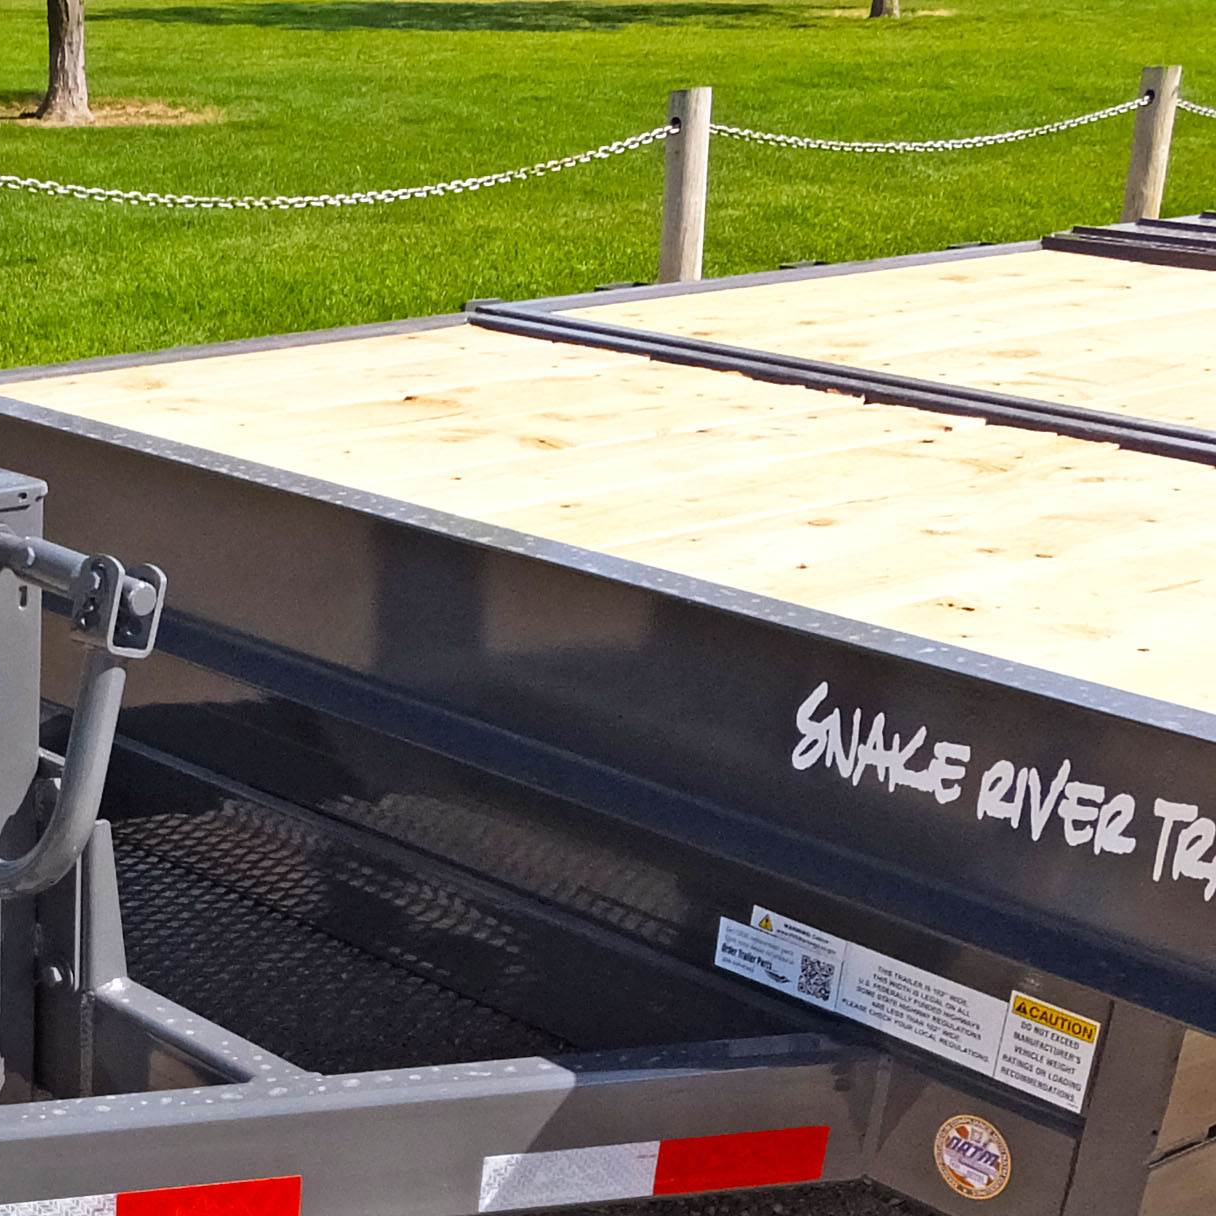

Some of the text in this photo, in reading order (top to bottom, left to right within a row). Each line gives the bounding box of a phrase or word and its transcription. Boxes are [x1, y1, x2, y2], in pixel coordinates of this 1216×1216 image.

[791, 681, 971, 804] SNAKE
[977, 759, 1137, 855] RIVER
[737, 949, 757, 964] Trailer
[873, 974, 971, 1018] THIS WIDTH IS LEGAL ON ALL
[894, 972, 923, 989] TRAILER
[856, 985, 982, 1041] SOME STATE HIGHWAY REGULATIONS
[872, 1001, 886, 1012] ARE
[886, 1007, 904, 1019] LESS
[906, 1013, 925, 1027] THAN
[873, 983, 913, 1003] FEDERALLY
[913, 999, 942, 1015] FUNDED
[842, 998, 867, 1013] PLEASE
[869, 1009, 892, 1023] CHECK
[893, 1018, 913, 1031] YOUR
[914, 1028, 937, 1042] LOCAL
[1021, 1021, 1080, 1050] DO NOT EXCEED
[1029, 1006, 1094, 1040] CAUTION
[1013, 1031, 1081, 1065] MANUFACTURER'S
[1014, 1045, 1076, 1075] VEHICLE WEIGHT
[1002, 1054, 1082, 1092] RATINGS OR LOADING
